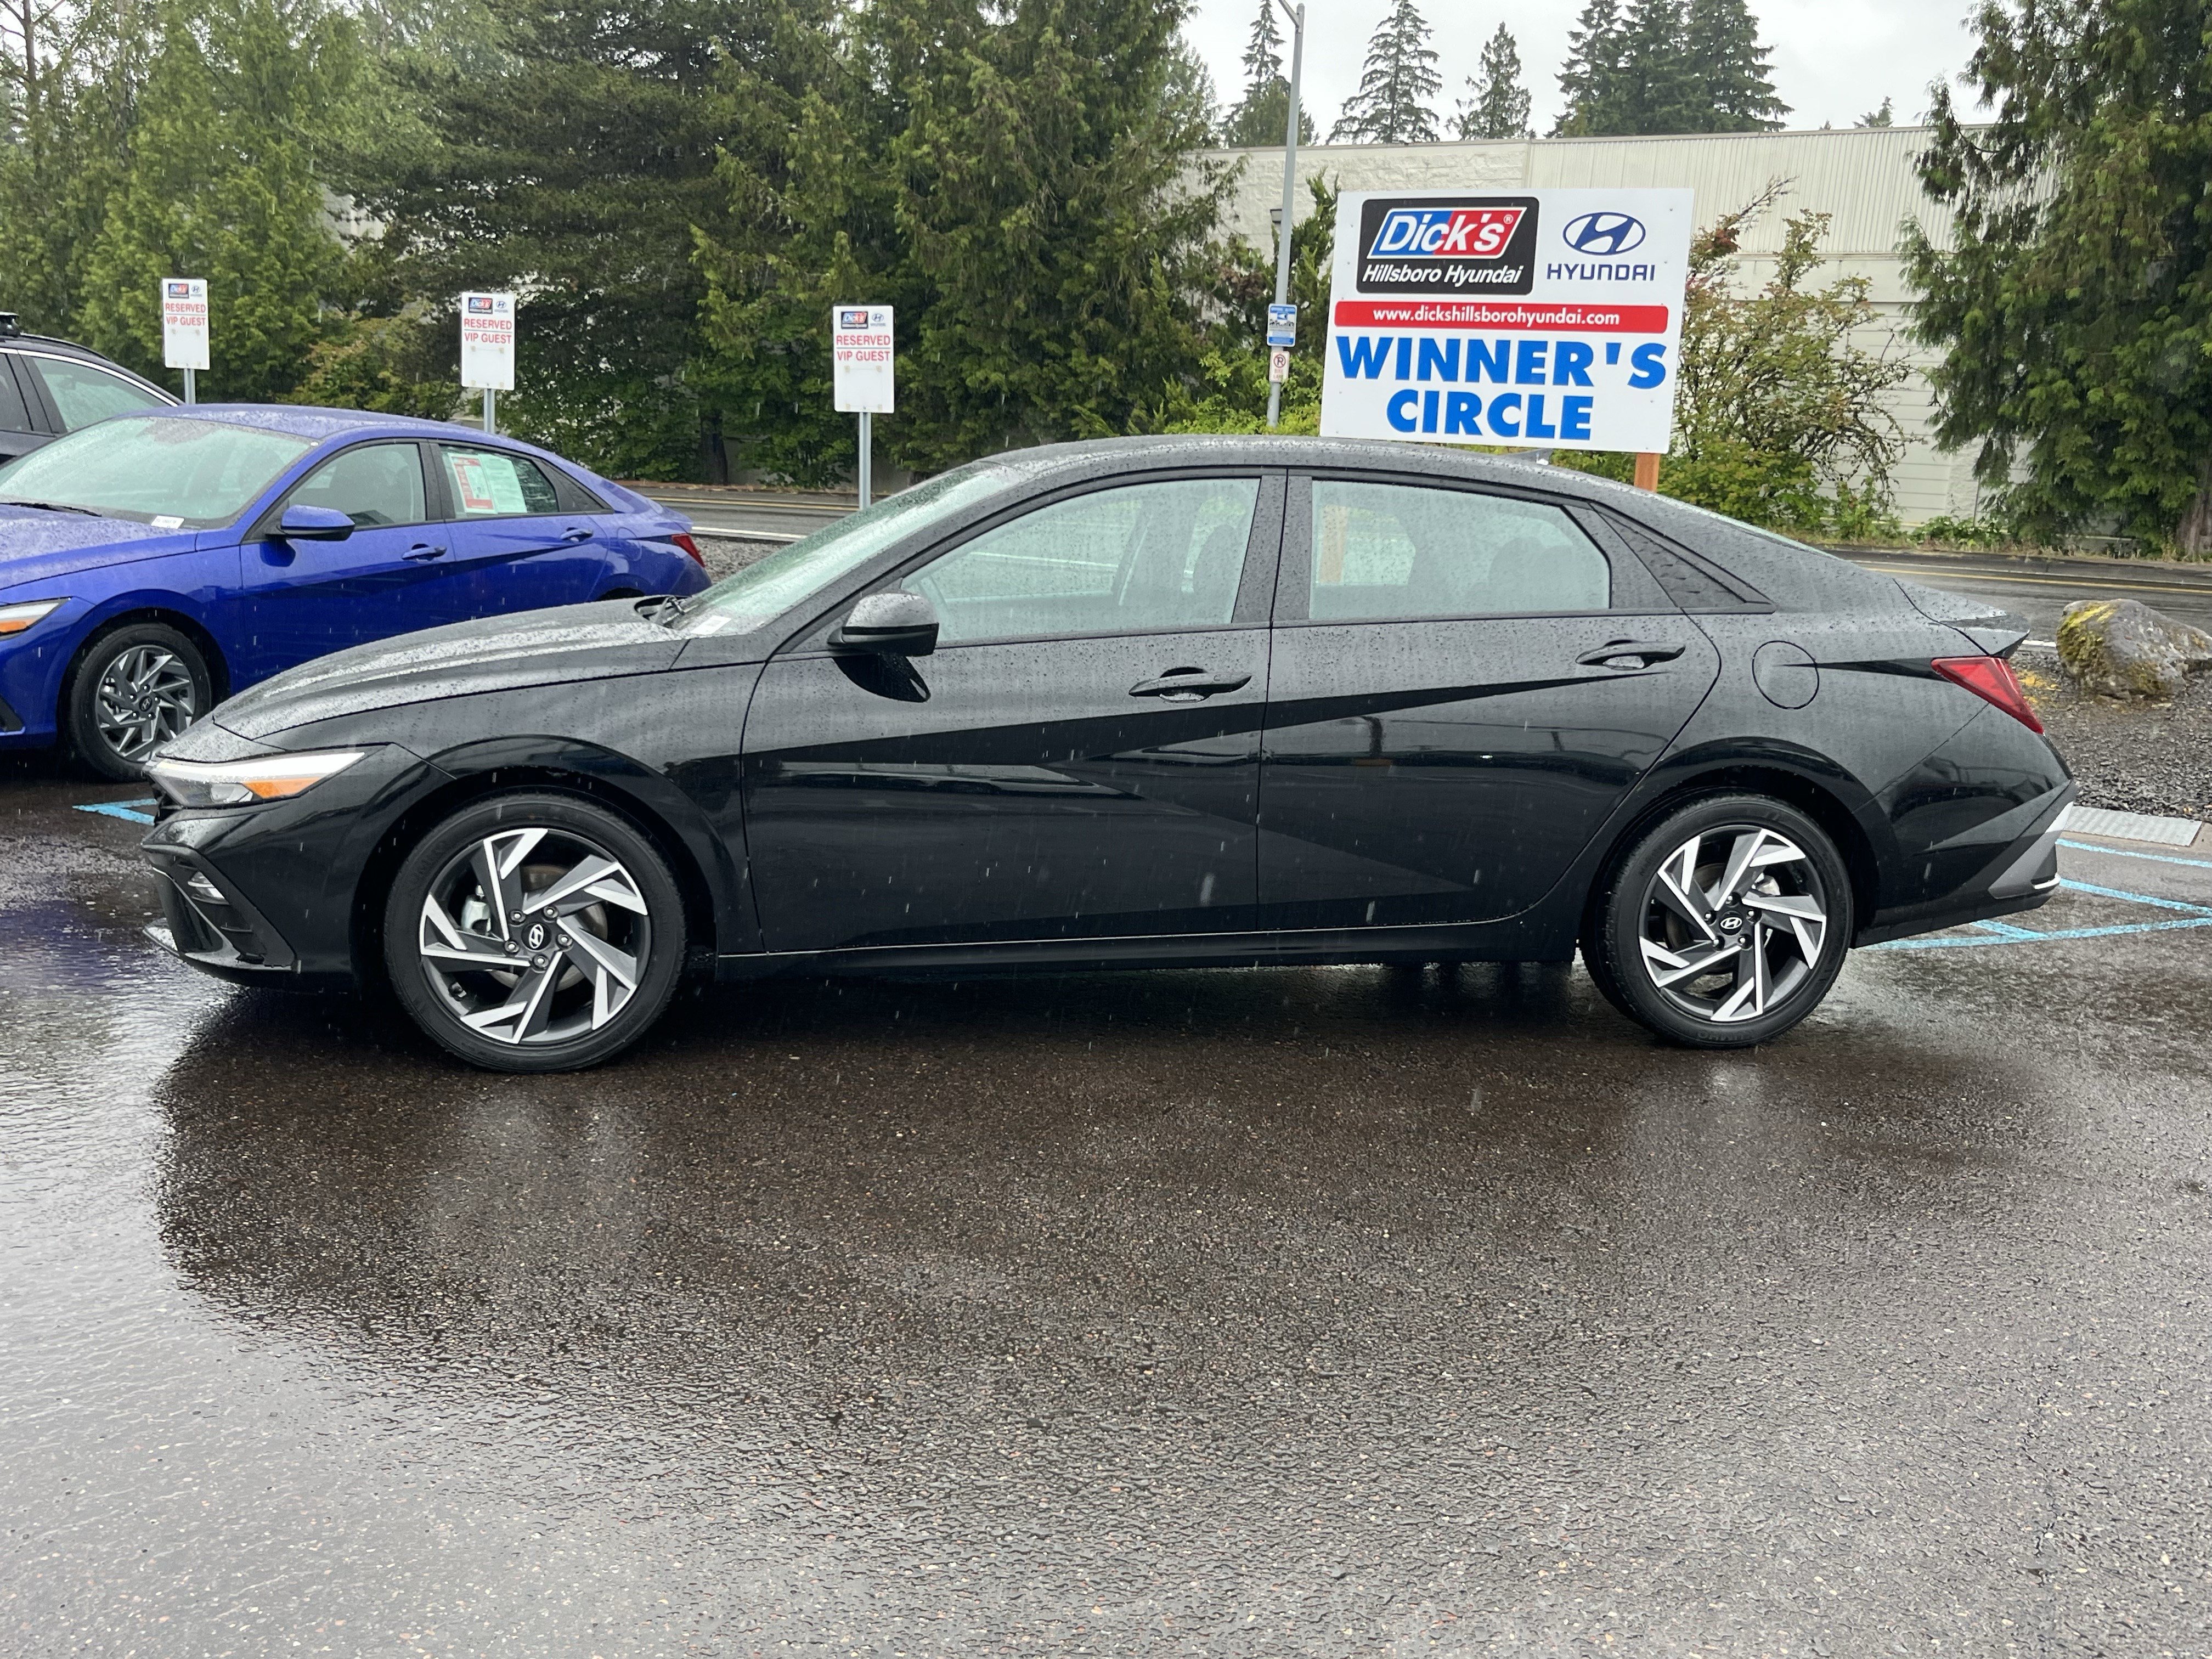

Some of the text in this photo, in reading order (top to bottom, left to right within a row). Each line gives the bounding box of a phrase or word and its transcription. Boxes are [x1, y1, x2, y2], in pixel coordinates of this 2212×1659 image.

[1379, 213, 1505, 252] Dick's
[1362, 264, 1524, 287] Hillsboro Hyundai
[1547, 263, 1655, 281] HYUNDAI
[165, 303, 206, 313] RESERVED
[166, 316, 206, 326] VIP GUEST
[464, 318, 512, 330] RESERVED
[1373, 305, 1620, 328] www.dickshillsborohyundai.com
[465, 332, 512, 344] VIP GUEST
[836, 334, 891, 346] RESERVED
[837, 350, 890, 362] VIP GUEST
[1336, 335, 1667, 390] WINNER'S
[1386, 389, 1594, 440] CIRCLE
